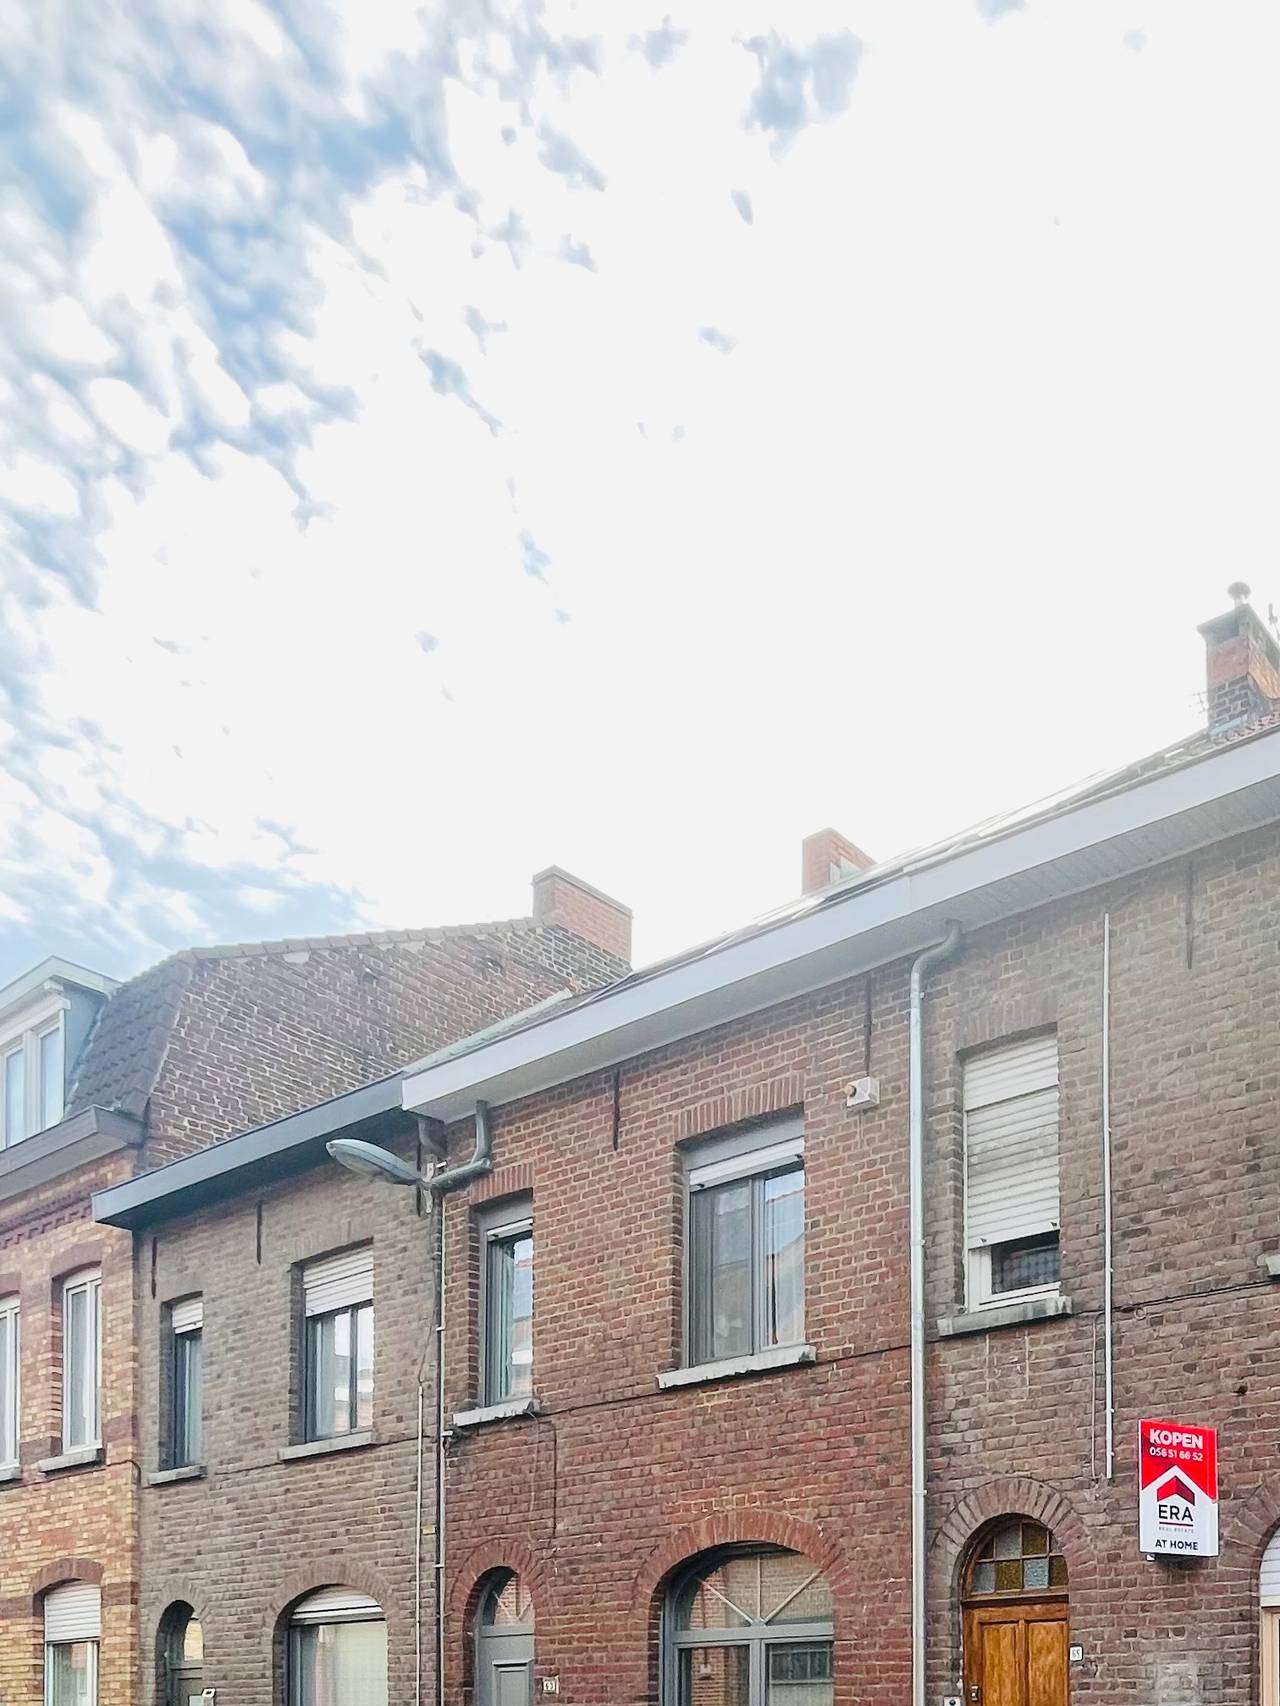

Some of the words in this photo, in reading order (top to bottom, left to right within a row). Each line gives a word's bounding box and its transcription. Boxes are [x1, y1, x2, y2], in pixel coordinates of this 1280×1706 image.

[1149, 1429, 1203, 1449] KOPEN
[1168, 1449, 1177, 1458] 51
[1192, 1452, 1203, 1462] 52
[1158, 1504, 1194, 1522] ERA
[1155, 1539, 1167, 1548] AT
[1170, 1540, 1198, 1550] HOME
